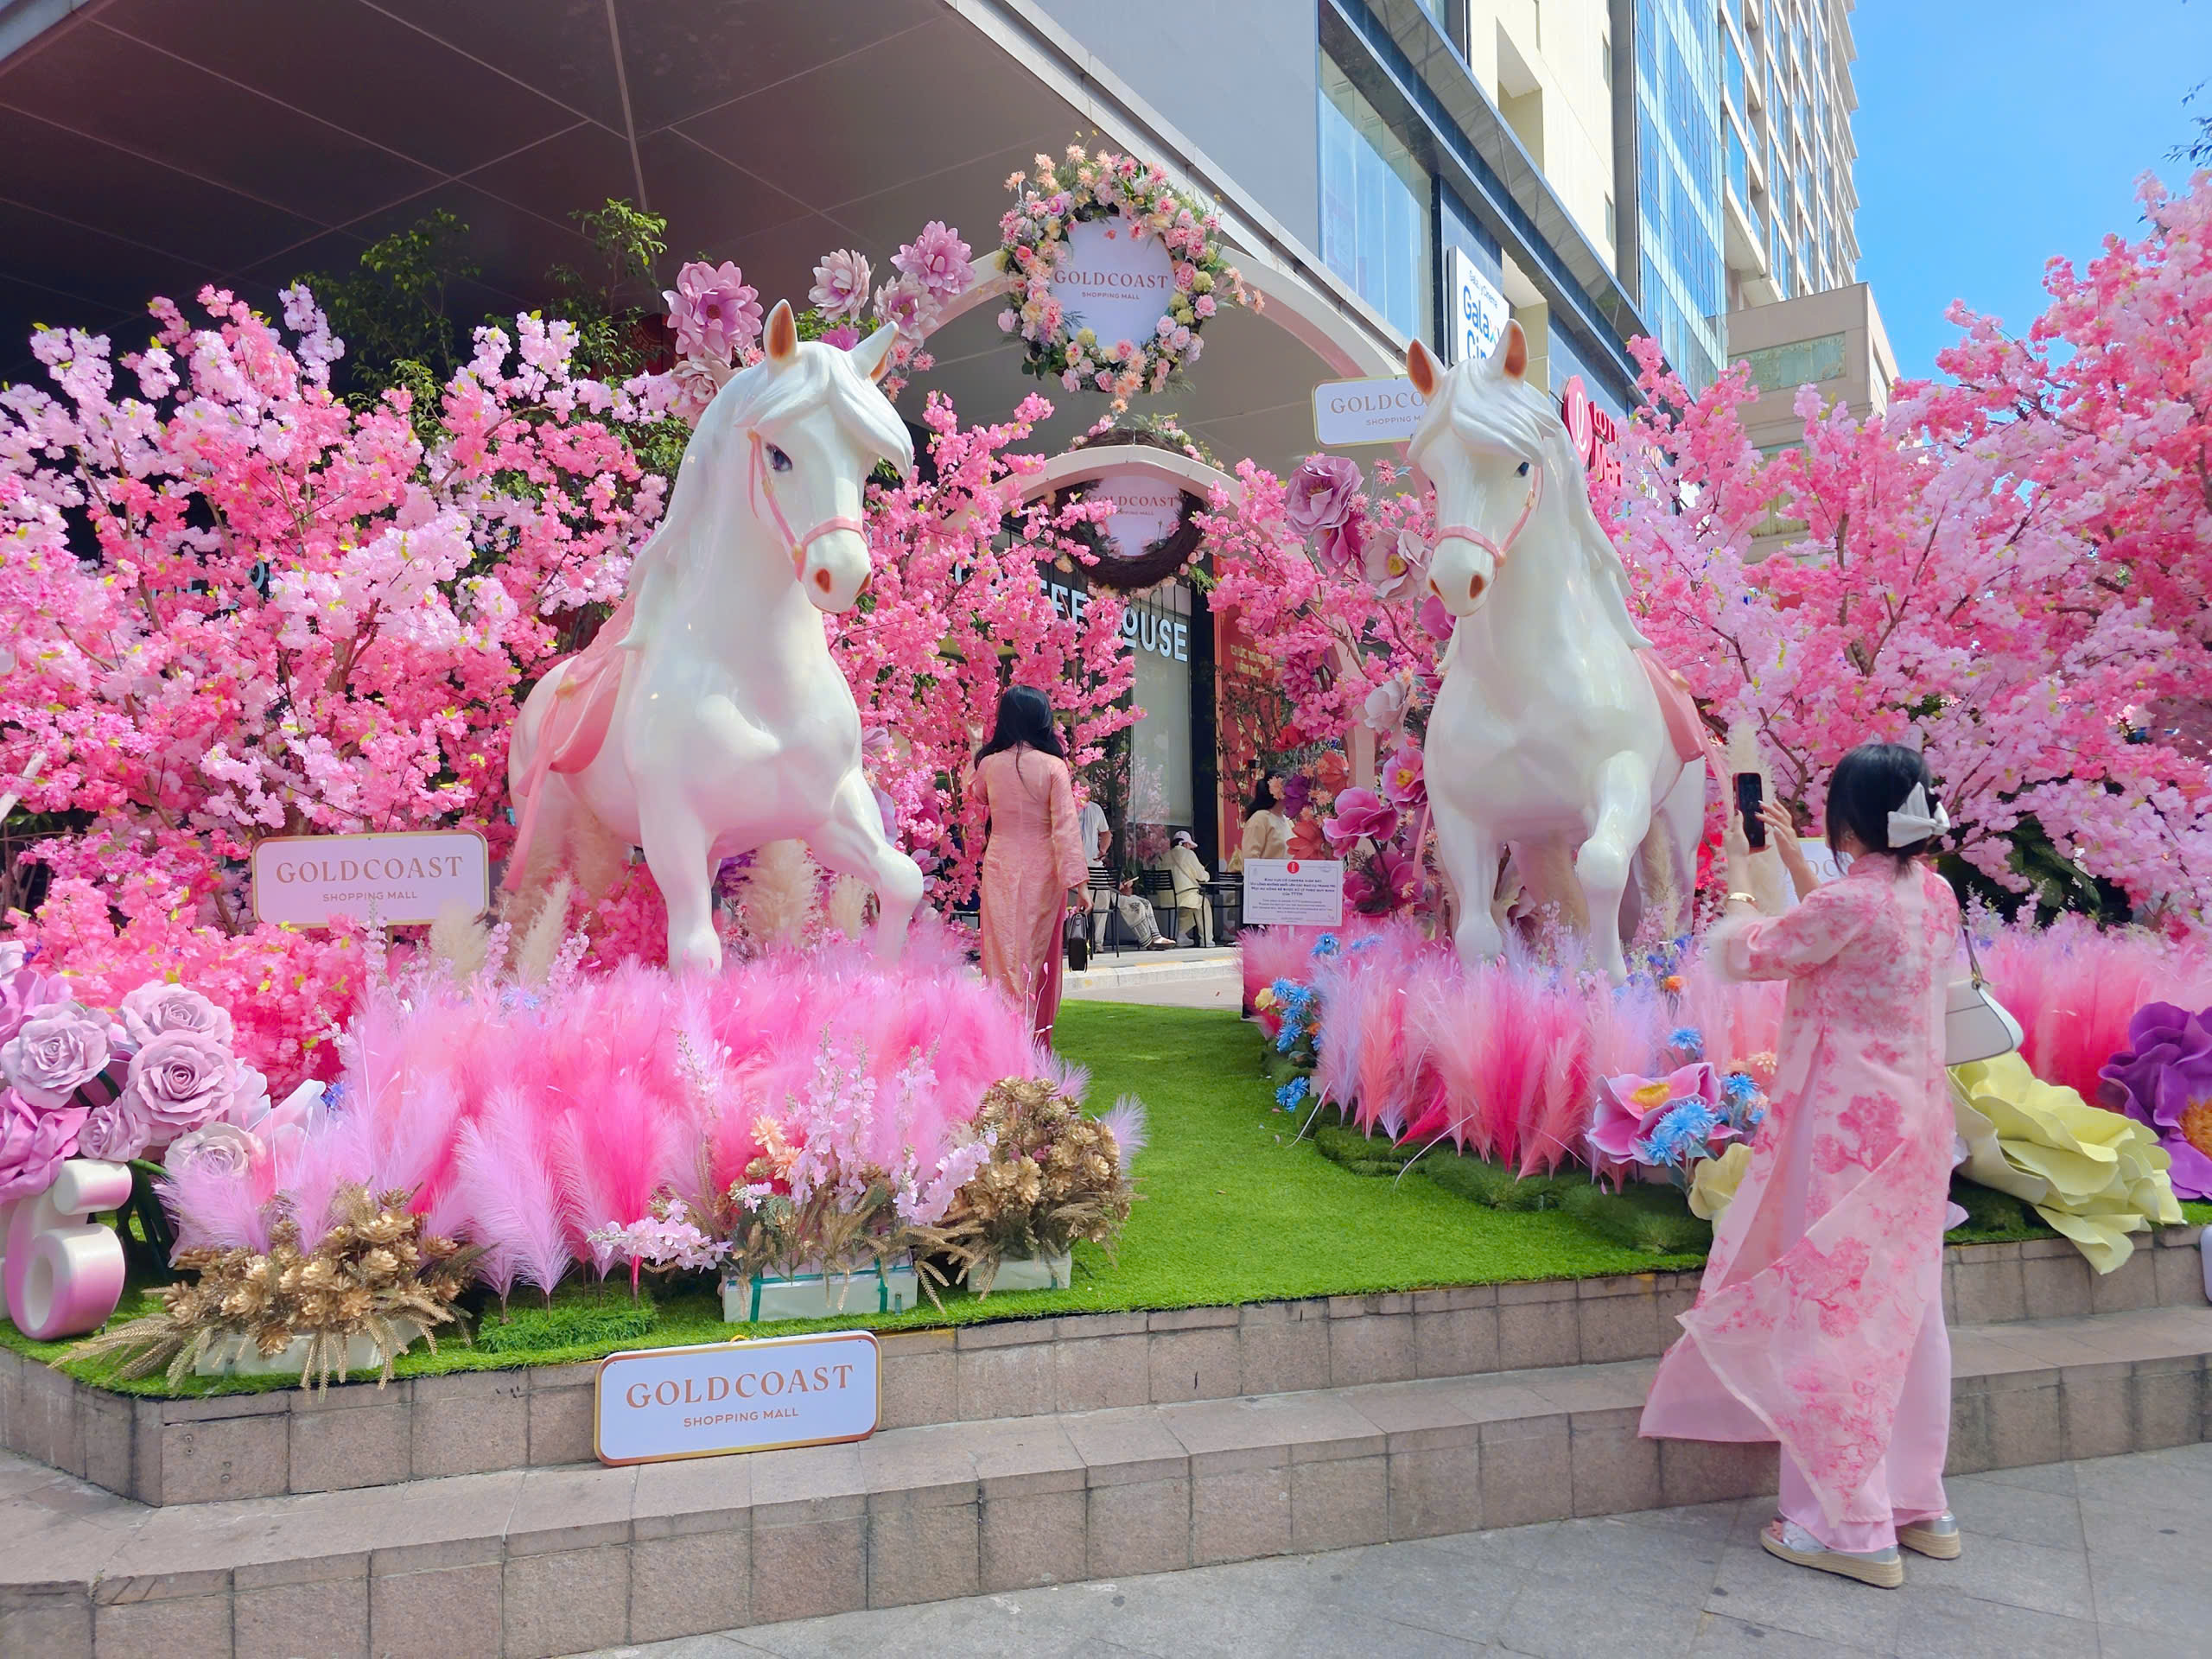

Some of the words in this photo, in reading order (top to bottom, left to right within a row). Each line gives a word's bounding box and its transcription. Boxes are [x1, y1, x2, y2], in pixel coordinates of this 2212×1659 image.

[1054, 270, 1168, 289] GOLDCOAST
[1463, 285, 1500, 346] Galax
[1331, 391, 1425, 414] GOLDCO
[1366, 416, 1412, 426] SHOPPING
[1114, 606, 1188, 663] OUSE
[276, 855, 463, 884] GOLDCOAST
[322, 892, 384, 902] SHOPPING
[387, 891, 418, 899] MALL
[0, 1159, 132, 1342] 6
[626, 1363, 855, 1408] GOLDCOAST
[683, 1410, 759, 1427] SHOPPING
[763, 1407, 800, 1419] MALL
